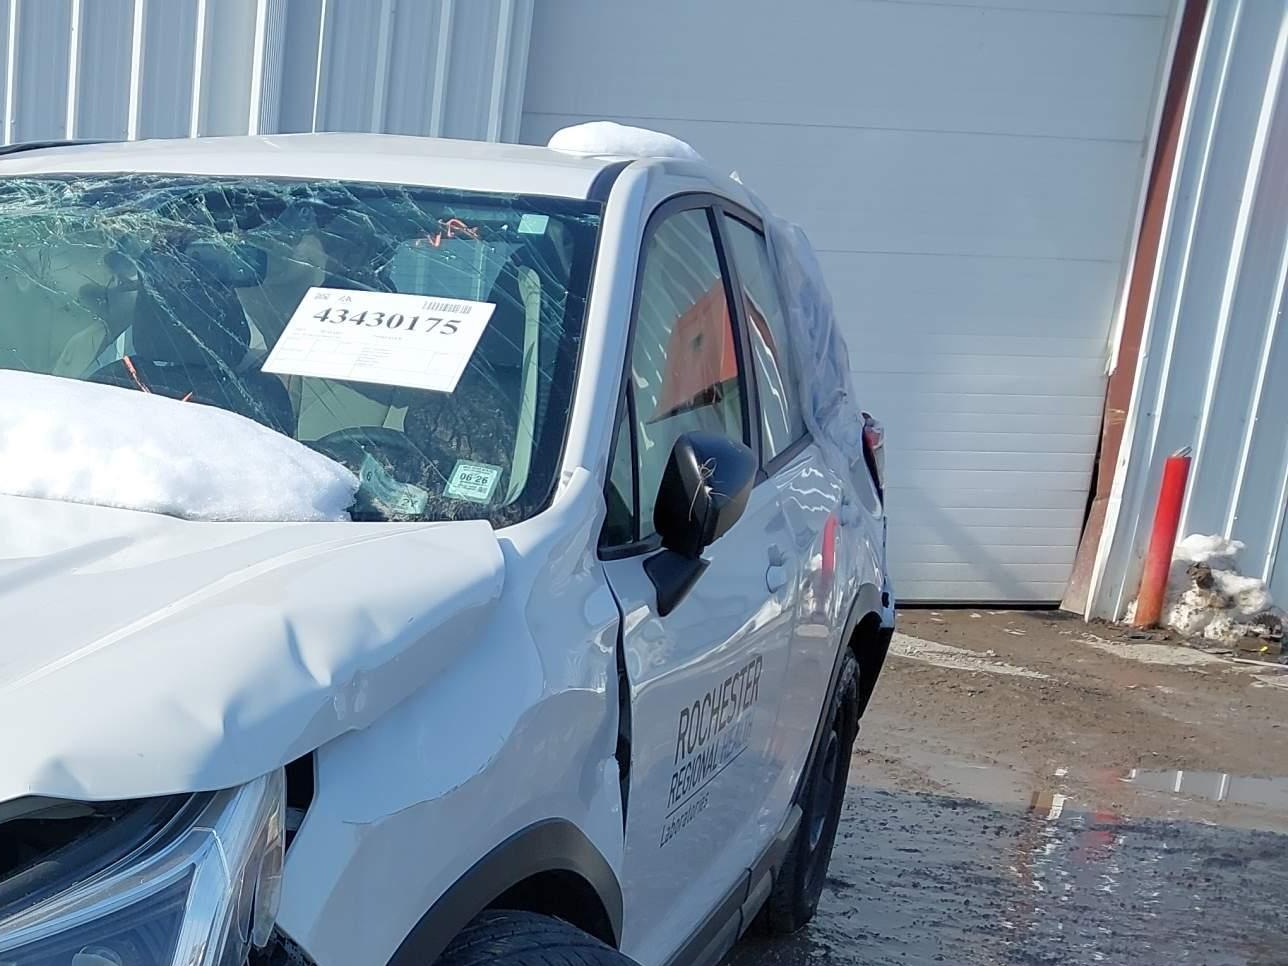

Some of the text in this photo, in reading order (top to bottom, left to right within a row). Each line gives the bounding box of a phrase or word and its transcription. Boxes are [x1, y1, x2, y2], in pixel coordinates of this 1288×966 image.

[312, 306, 462, 336] 43430175
[674, 655, 764, 765] ROCHESTER
[667, 738, 719, 809] REGIONAL
[659, 791, 711, 849] Laboratories
